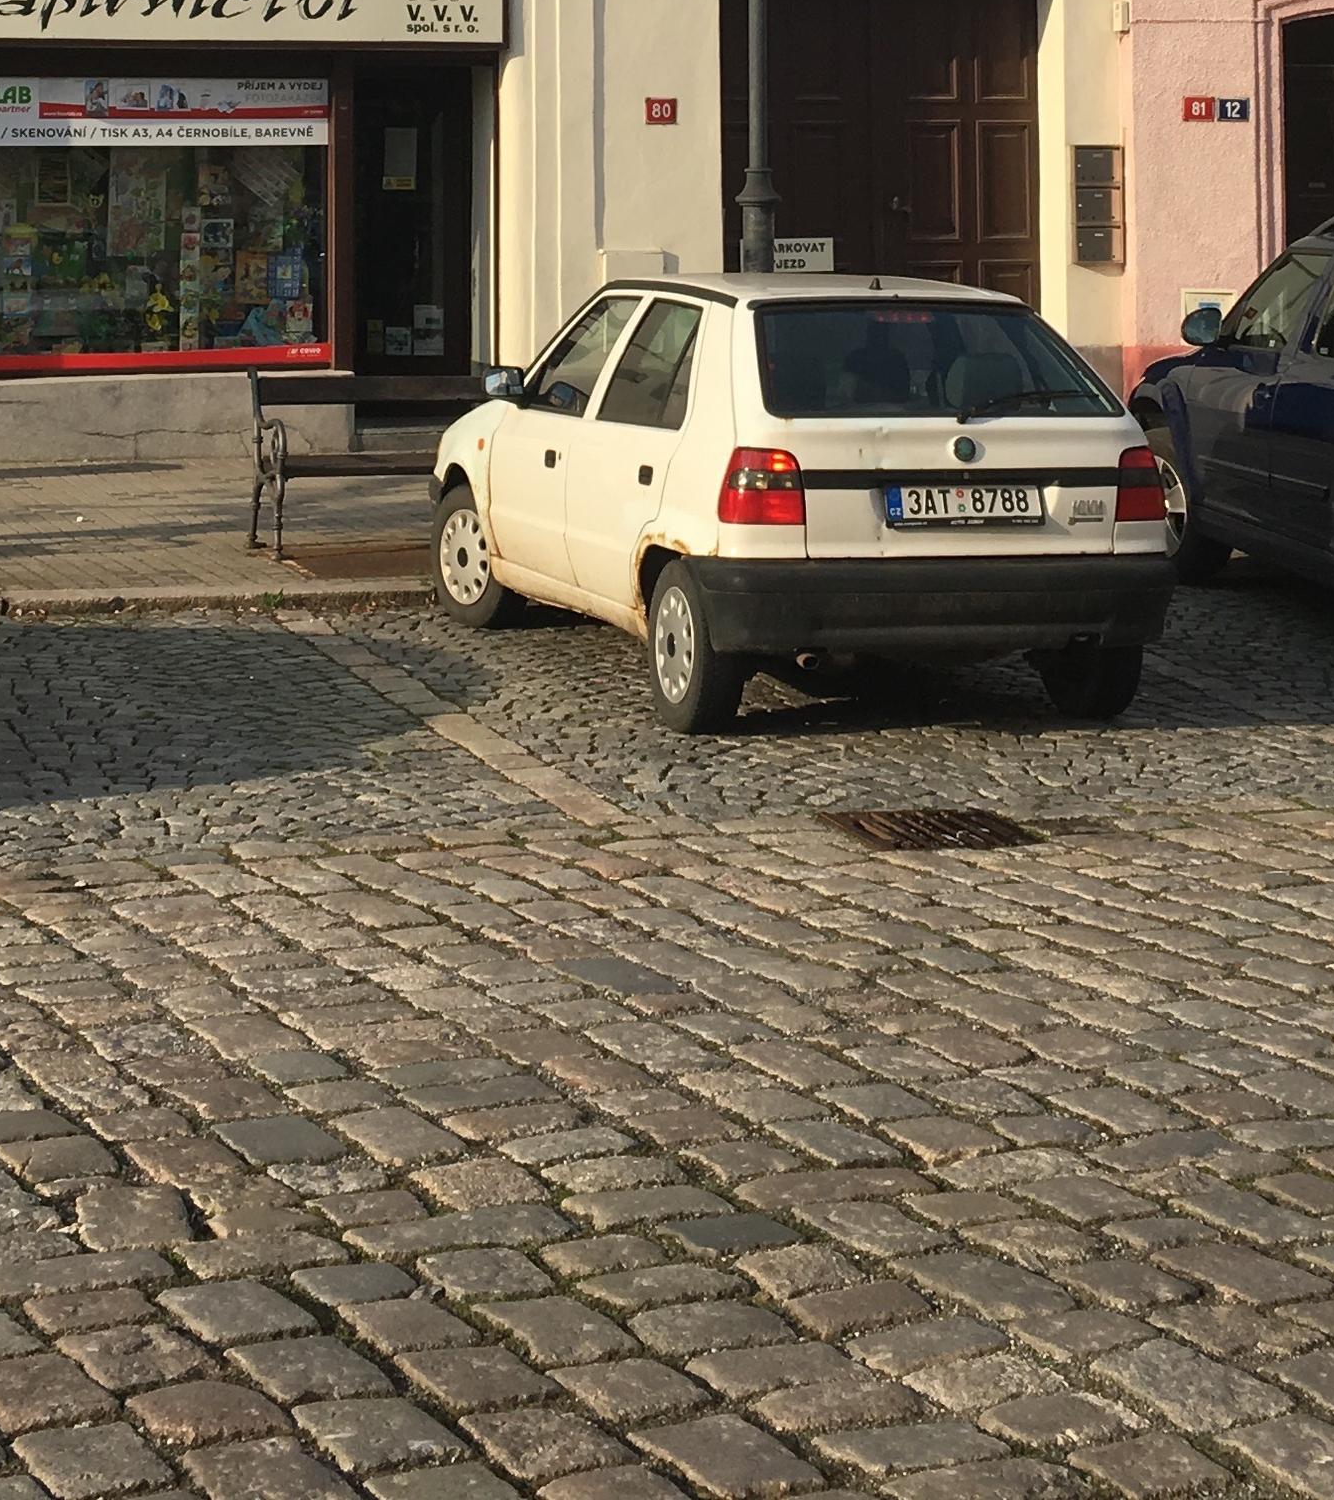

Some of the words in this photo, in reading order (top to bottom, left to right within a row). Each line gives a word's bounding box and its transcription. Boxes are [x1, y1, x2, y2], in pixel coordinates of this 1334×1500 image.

[407, 4, 425, 22] V.
[433, 5, 452, 22] V.
[460, 5, 479, 22] V.
[406, 22, 438, 35] spol.
[443, 24, 450, 33] s
[454, 24, 463, 33] r.
[467, 24, 479, 33] o.
[278, 82, 286, 90] A
[651, 102, 671, 118] 80
[1191, 101, 1206, 116] 81
[1225, 101, 1241, 118] 12
[11, 125, 87, 138] SKENOVÁNÍ
[100, 127, 128, 138] TISK
[132, 127, 152, 139] A3,
[156, 127, 173, 137] A4
[177, 125, 252, 139] ČERNOBÍLE,
[255, 126, 314, 137] BAREVNĚ
[773, 242, 826, 254] ARKOVAT
[773, 258, 806, 269] JEZD
[908, 489, 951, 515] 3AT
[971, 488, 1030, 513] 8788
[889, 507, 901, 516] CZ
